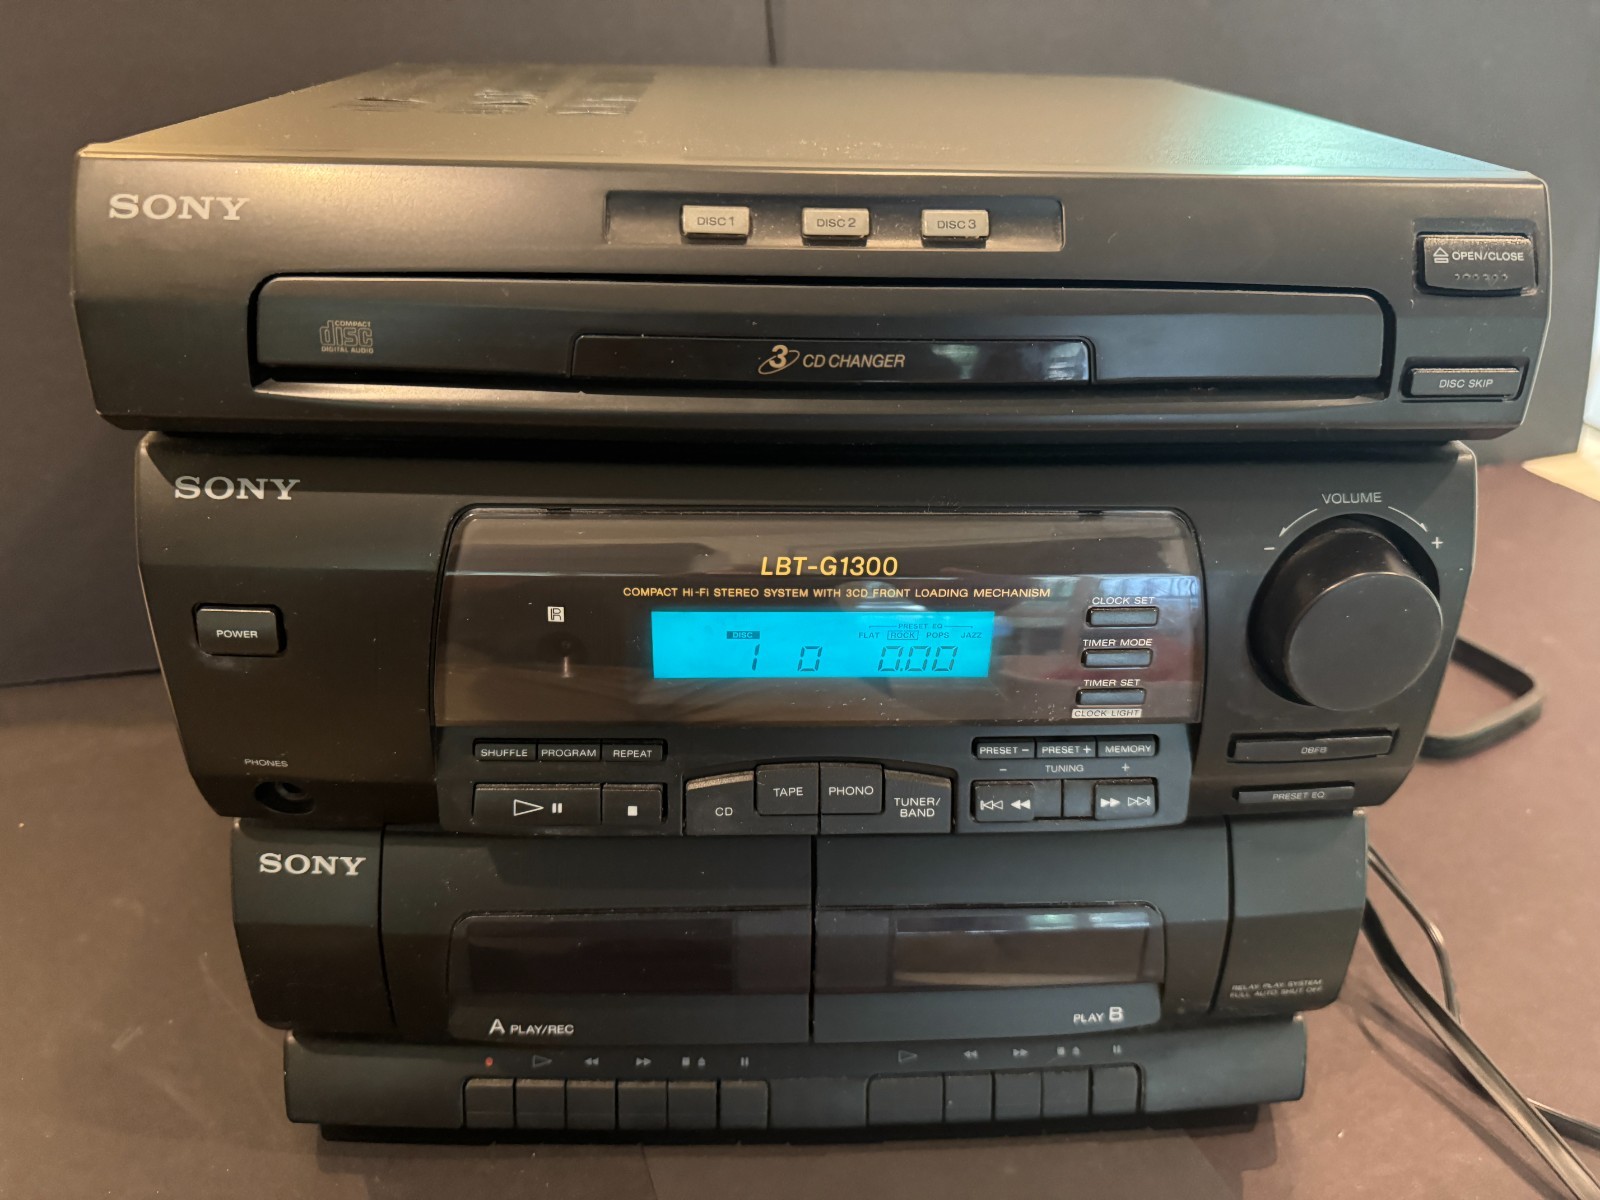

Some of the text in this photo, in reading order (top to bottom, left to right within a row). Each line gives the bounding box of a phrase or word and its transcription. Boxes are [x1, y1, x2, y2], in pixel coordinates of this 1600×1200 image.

[108, 193, 250, 221] SONY
[697, 216, 735, 226] DISC 1
[816, 217, 857, 228] DISC 2
[937, 219, 977, 230] DISC 3
[1451, 250, 1525, 262] OPEN/CLOSE
[334, 320, 371, 328] COMPACT
[769, 344, 906, 369] 3 CD CHANGER
[1438, 378, 1494, 389] DISC SKIP
[174, 475, 301, 501] SONY
[1321, 491, 1383, 505] VOLUME
[760, 555, 899, 577] LBT-G1300
[622, 586, 679, 598] COMPACT
[713, 587, 760, 599] STEREO
[763, 587, 809, 599] SYSTEM
[812, 587, 842, 598] WITH
[845, 587, 869, 599] 3CD
[872, 587, 911, 599] FRONT
[914, 587, 969, 599] LOADING
[972, 587, 1051, 599] MECHANISM
[1091, 596, 1156, 605] CLOCK SET
[216, 628, 259, 640] POWER
[732, 631, 753, 639] DISC
[858, 631, 881, 639] FLAT
[889, 631, 916, 639] ROCK
[926, 631, 950, 639] POPS
[960, 631, 983, 639] JAZZ
[1082, 638, 1154, 648] TIMER MODE
[751, 643, 761, 672] 1
[1083, 678, 1142, 688] TIMER SET
[1074, 709, 1140, 718] CLOCK LIGHT
[480, 748, 528, 758] SHUFFLE
[541, 748, 597, 758] PROGRAM
[612, 749, 653, 759] REPEAT
[979, 746, 1019, 756] PRESET
[1041, 745, 1080, 755] PRESET
[1105, 744, 1152, 754] MEMORY
[1300, 746, 1328, 755] DBFB
[244, 758, 289, 769] PHONES
[1045, 763, 1085, 774] TUNING
[773, 786, 804, 798] TAPE
[828, 785, 874, 797] PHONO
[1272, 790, 1326, 801] PRESET EQ
[894, 797, 941, 807] TUNER/
[715, 806, 734, 817] CD
[900, 808, 936, 818] BAND
[258, 852, 366, 877] SONY
[1287, 979, 1322, 988] SYSTEM
[1254, 988, 1278, 996] AUTO
[1073, 1006, 1125, 1024] PLAY B
[488, 1018, 575, 1036] A PLAY/REC
